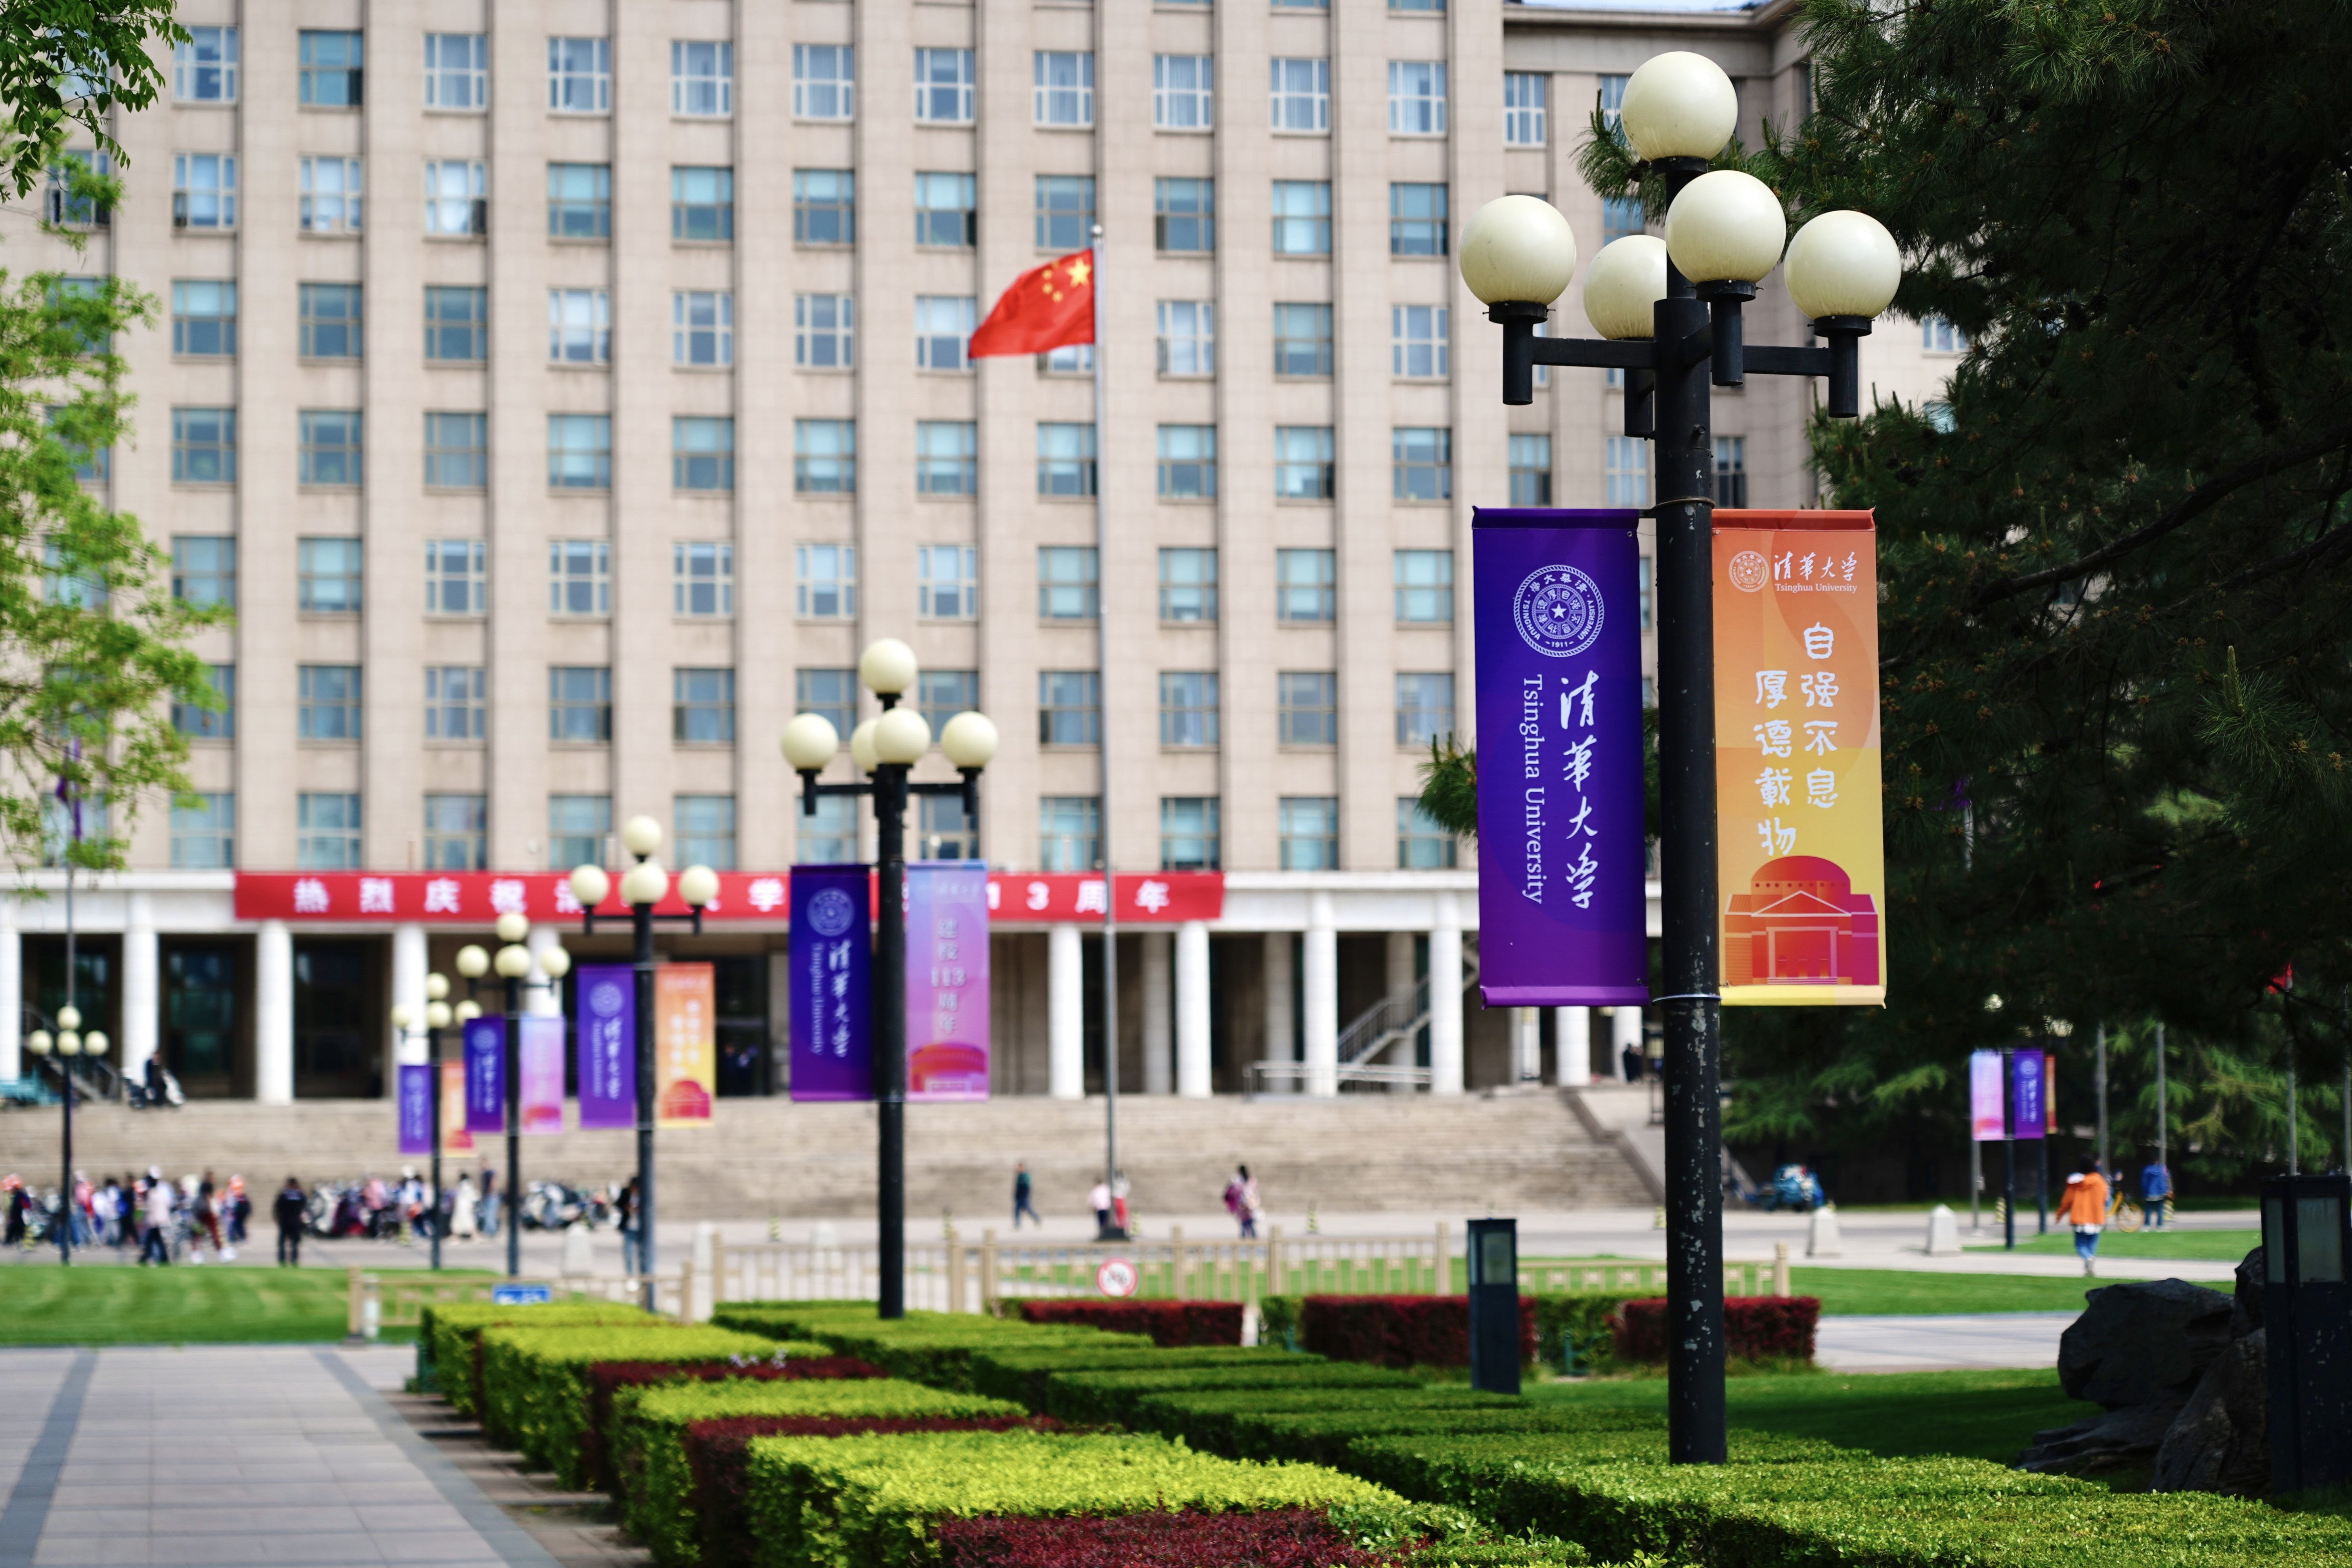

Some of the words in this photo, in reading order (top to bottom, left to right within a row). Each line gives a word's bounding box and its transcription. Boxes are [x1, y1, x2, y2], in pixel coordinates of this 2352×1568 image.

[1522, 600, 1541, 640] TSINGHUA
[1577, 600, 1596, 640] UNIVERSITY
[1775, 583, 1813, 593] Tsinghua
[1815, 583, 1857, 594] University
[1519, 674, 1545, 779] Tsinghua
[1801, 621, 1839, 809] 自强不息
[1522, 786, 1547, 904] University
